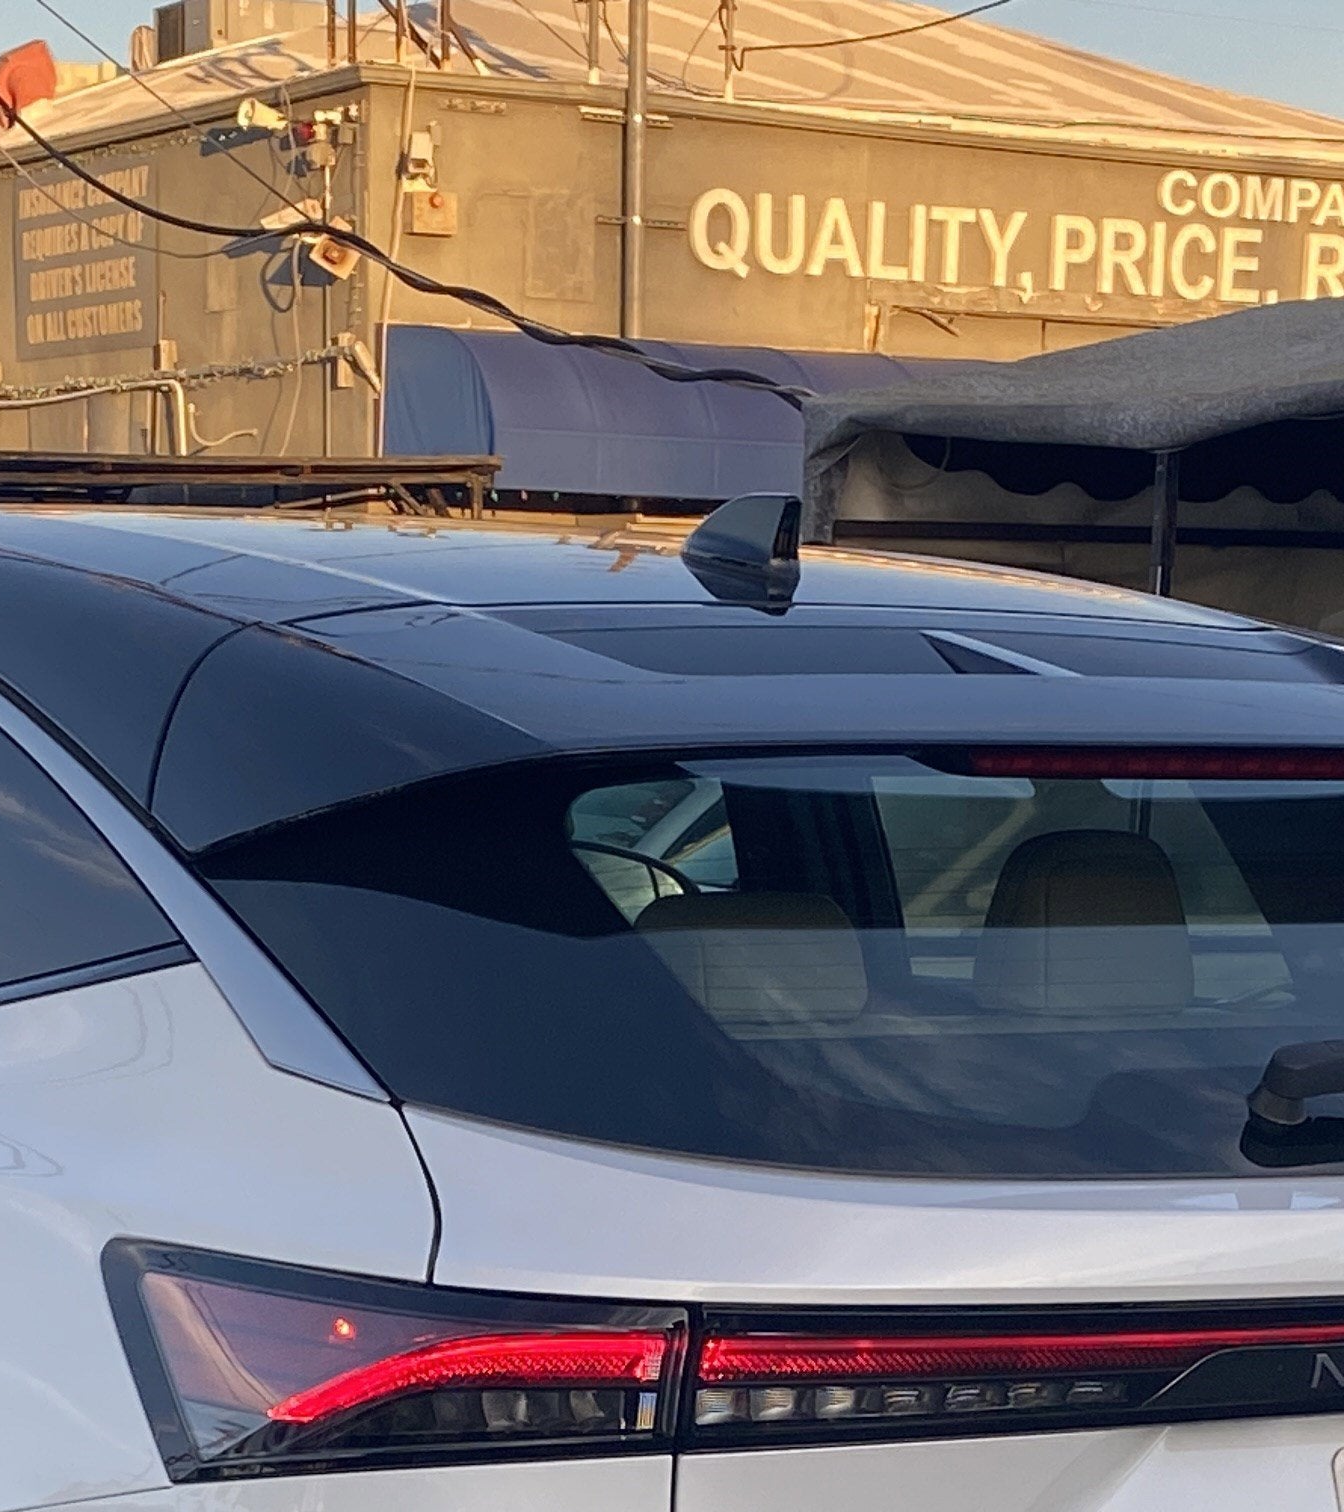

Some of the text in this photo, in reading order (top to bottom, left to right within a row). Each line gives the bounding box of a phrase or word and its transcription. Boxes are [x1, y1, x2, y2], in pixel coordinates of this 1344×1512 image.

[688, 186, 1033, 302] QUALITY,
[85, 256, 136, 293] LICENSE
[67, 299, 143, 339] CUSTOMERS
